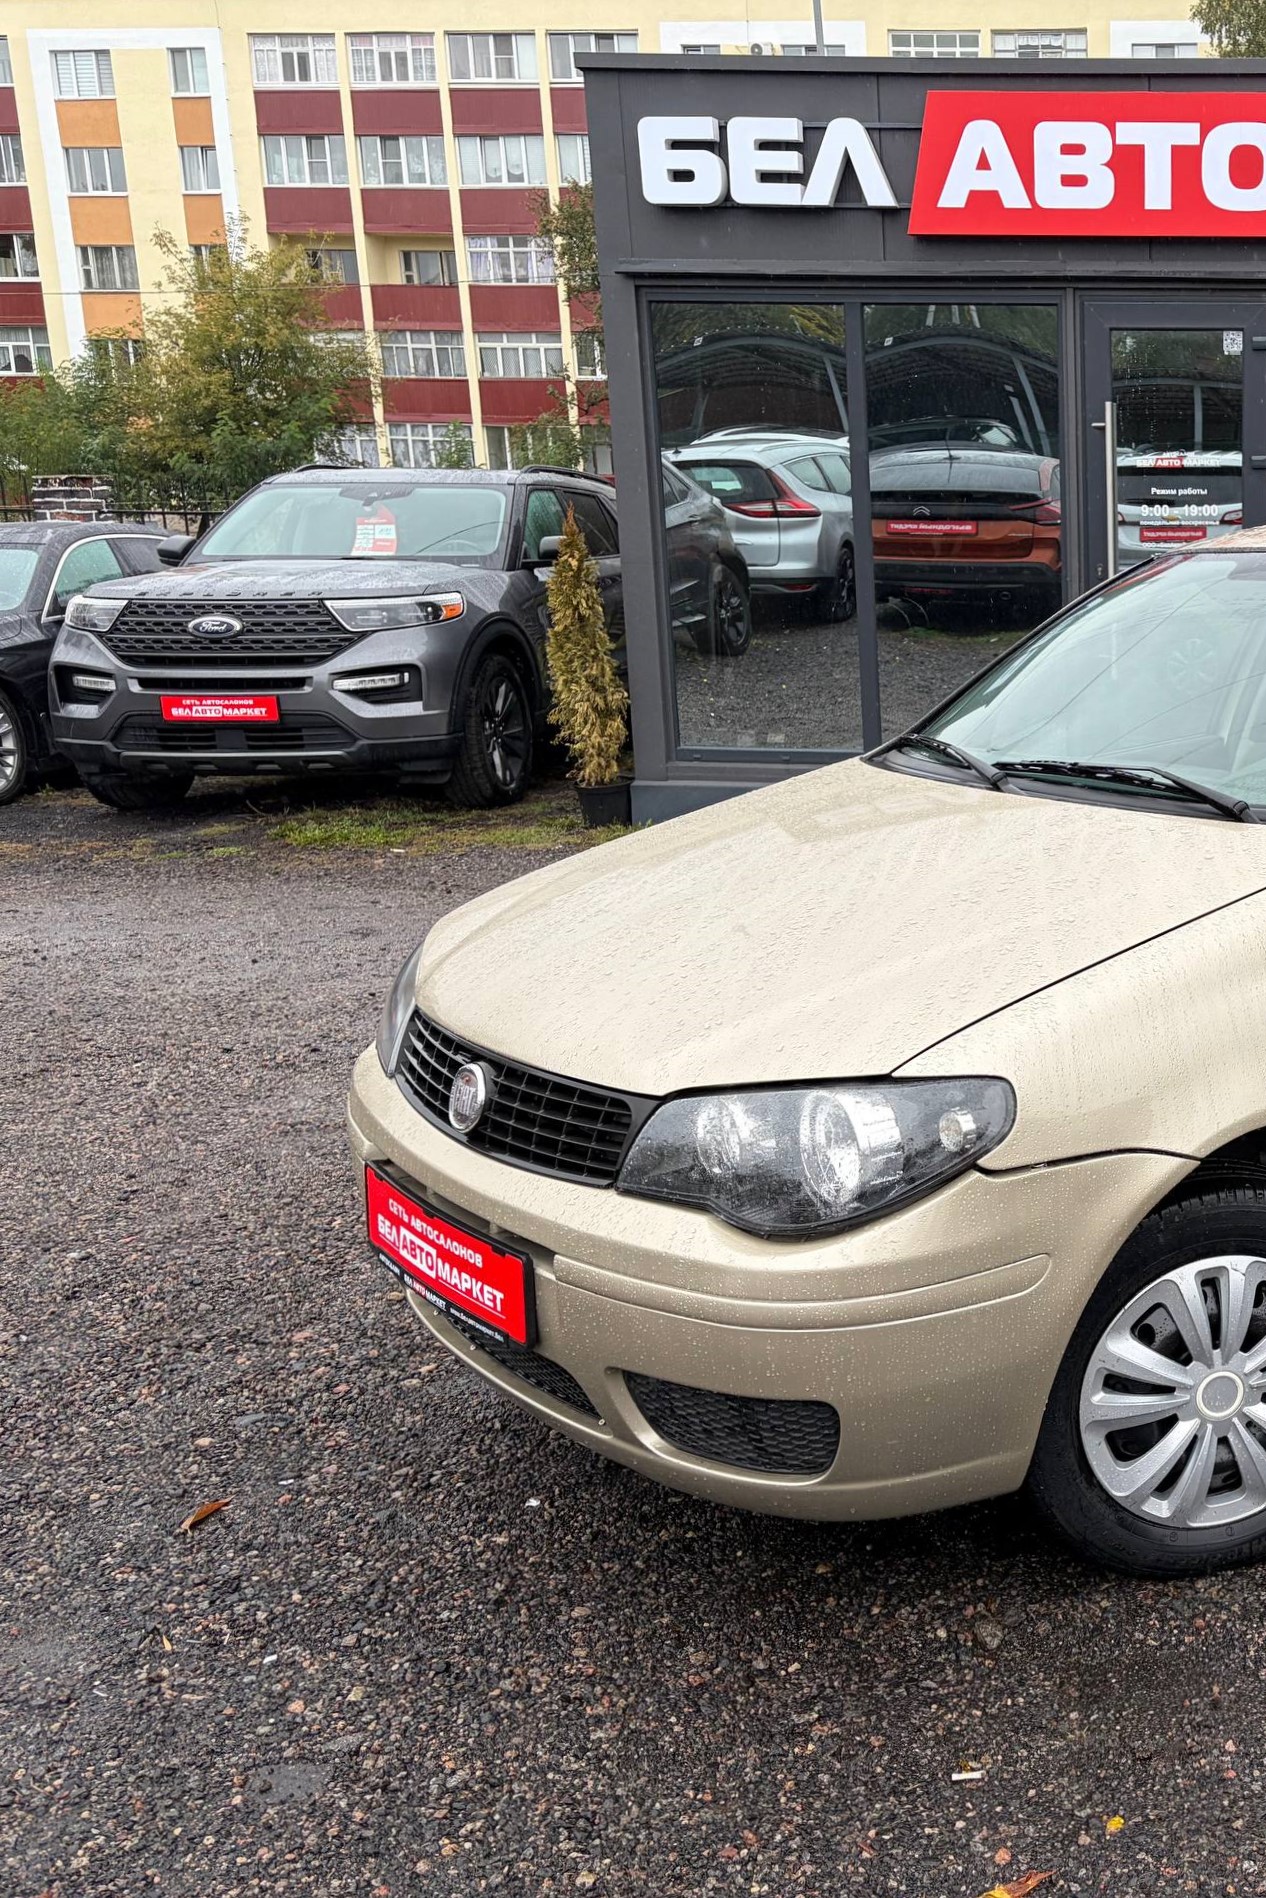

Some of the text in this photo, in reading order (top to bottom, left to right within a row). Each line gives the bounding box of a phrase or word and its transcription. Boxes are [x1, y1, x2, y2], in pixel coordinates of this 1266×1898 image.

[637, 116, 899, 208] БЕЛ
[1156, 459, 1180, 467] АВТО
[1183, 459, 1220, 467] МАРКЕТ
[1151, 487, 1207, 497] Режим работы
[1141, 504, 1170, 516] 9:00
[1184, 504, 1219, 516] 19:00
[200, 620, 227, 632] Ford
[171, 707, 268, 716] БЕЛ АВТО МАРКЕТ
[388, 1198, 483, 1268] СЕТЬ АВТОСАЛОНОВ
[377, 1213, 504, 1312] БЕЛ АВТО МАРКЕТ
[413, 1280, 426, 1296] АВТО
[425, 1289, 447, 1312] МАРКЕТ
